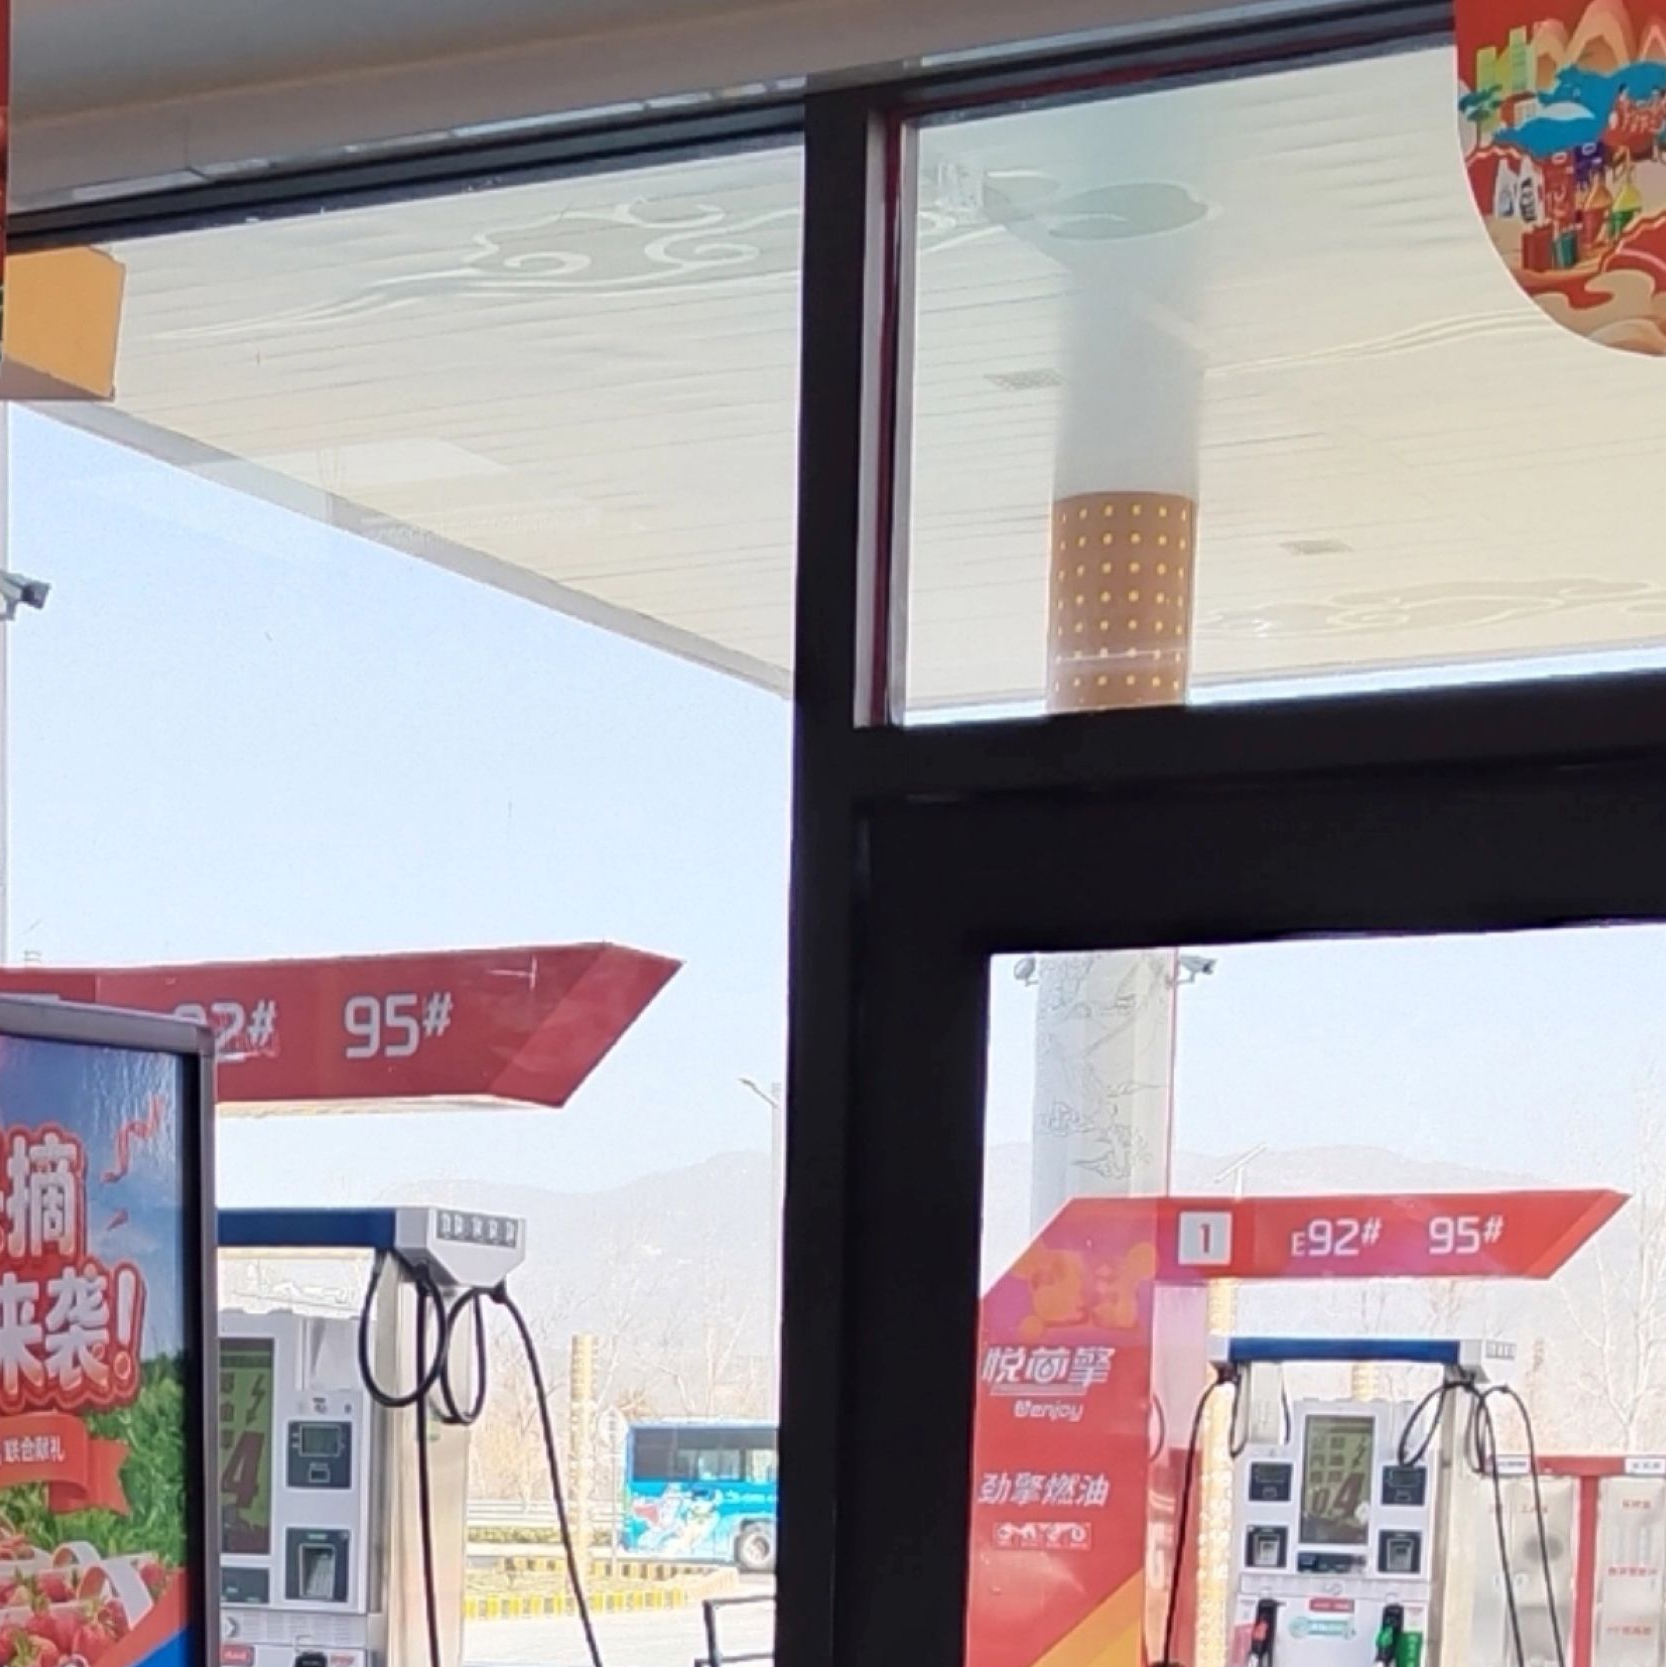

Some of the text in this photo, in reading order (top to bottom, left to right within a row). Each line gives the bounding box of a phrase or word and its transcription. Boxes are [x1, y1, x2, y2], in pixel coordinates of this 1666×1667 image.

[344, 992, 453, 1060] 95#
[1198, 1223, 1211, 1254] 1
[1428, 1215, 1505, 1254] 95#
[978, 1472, 1111, 1508] 劲擎燃油
